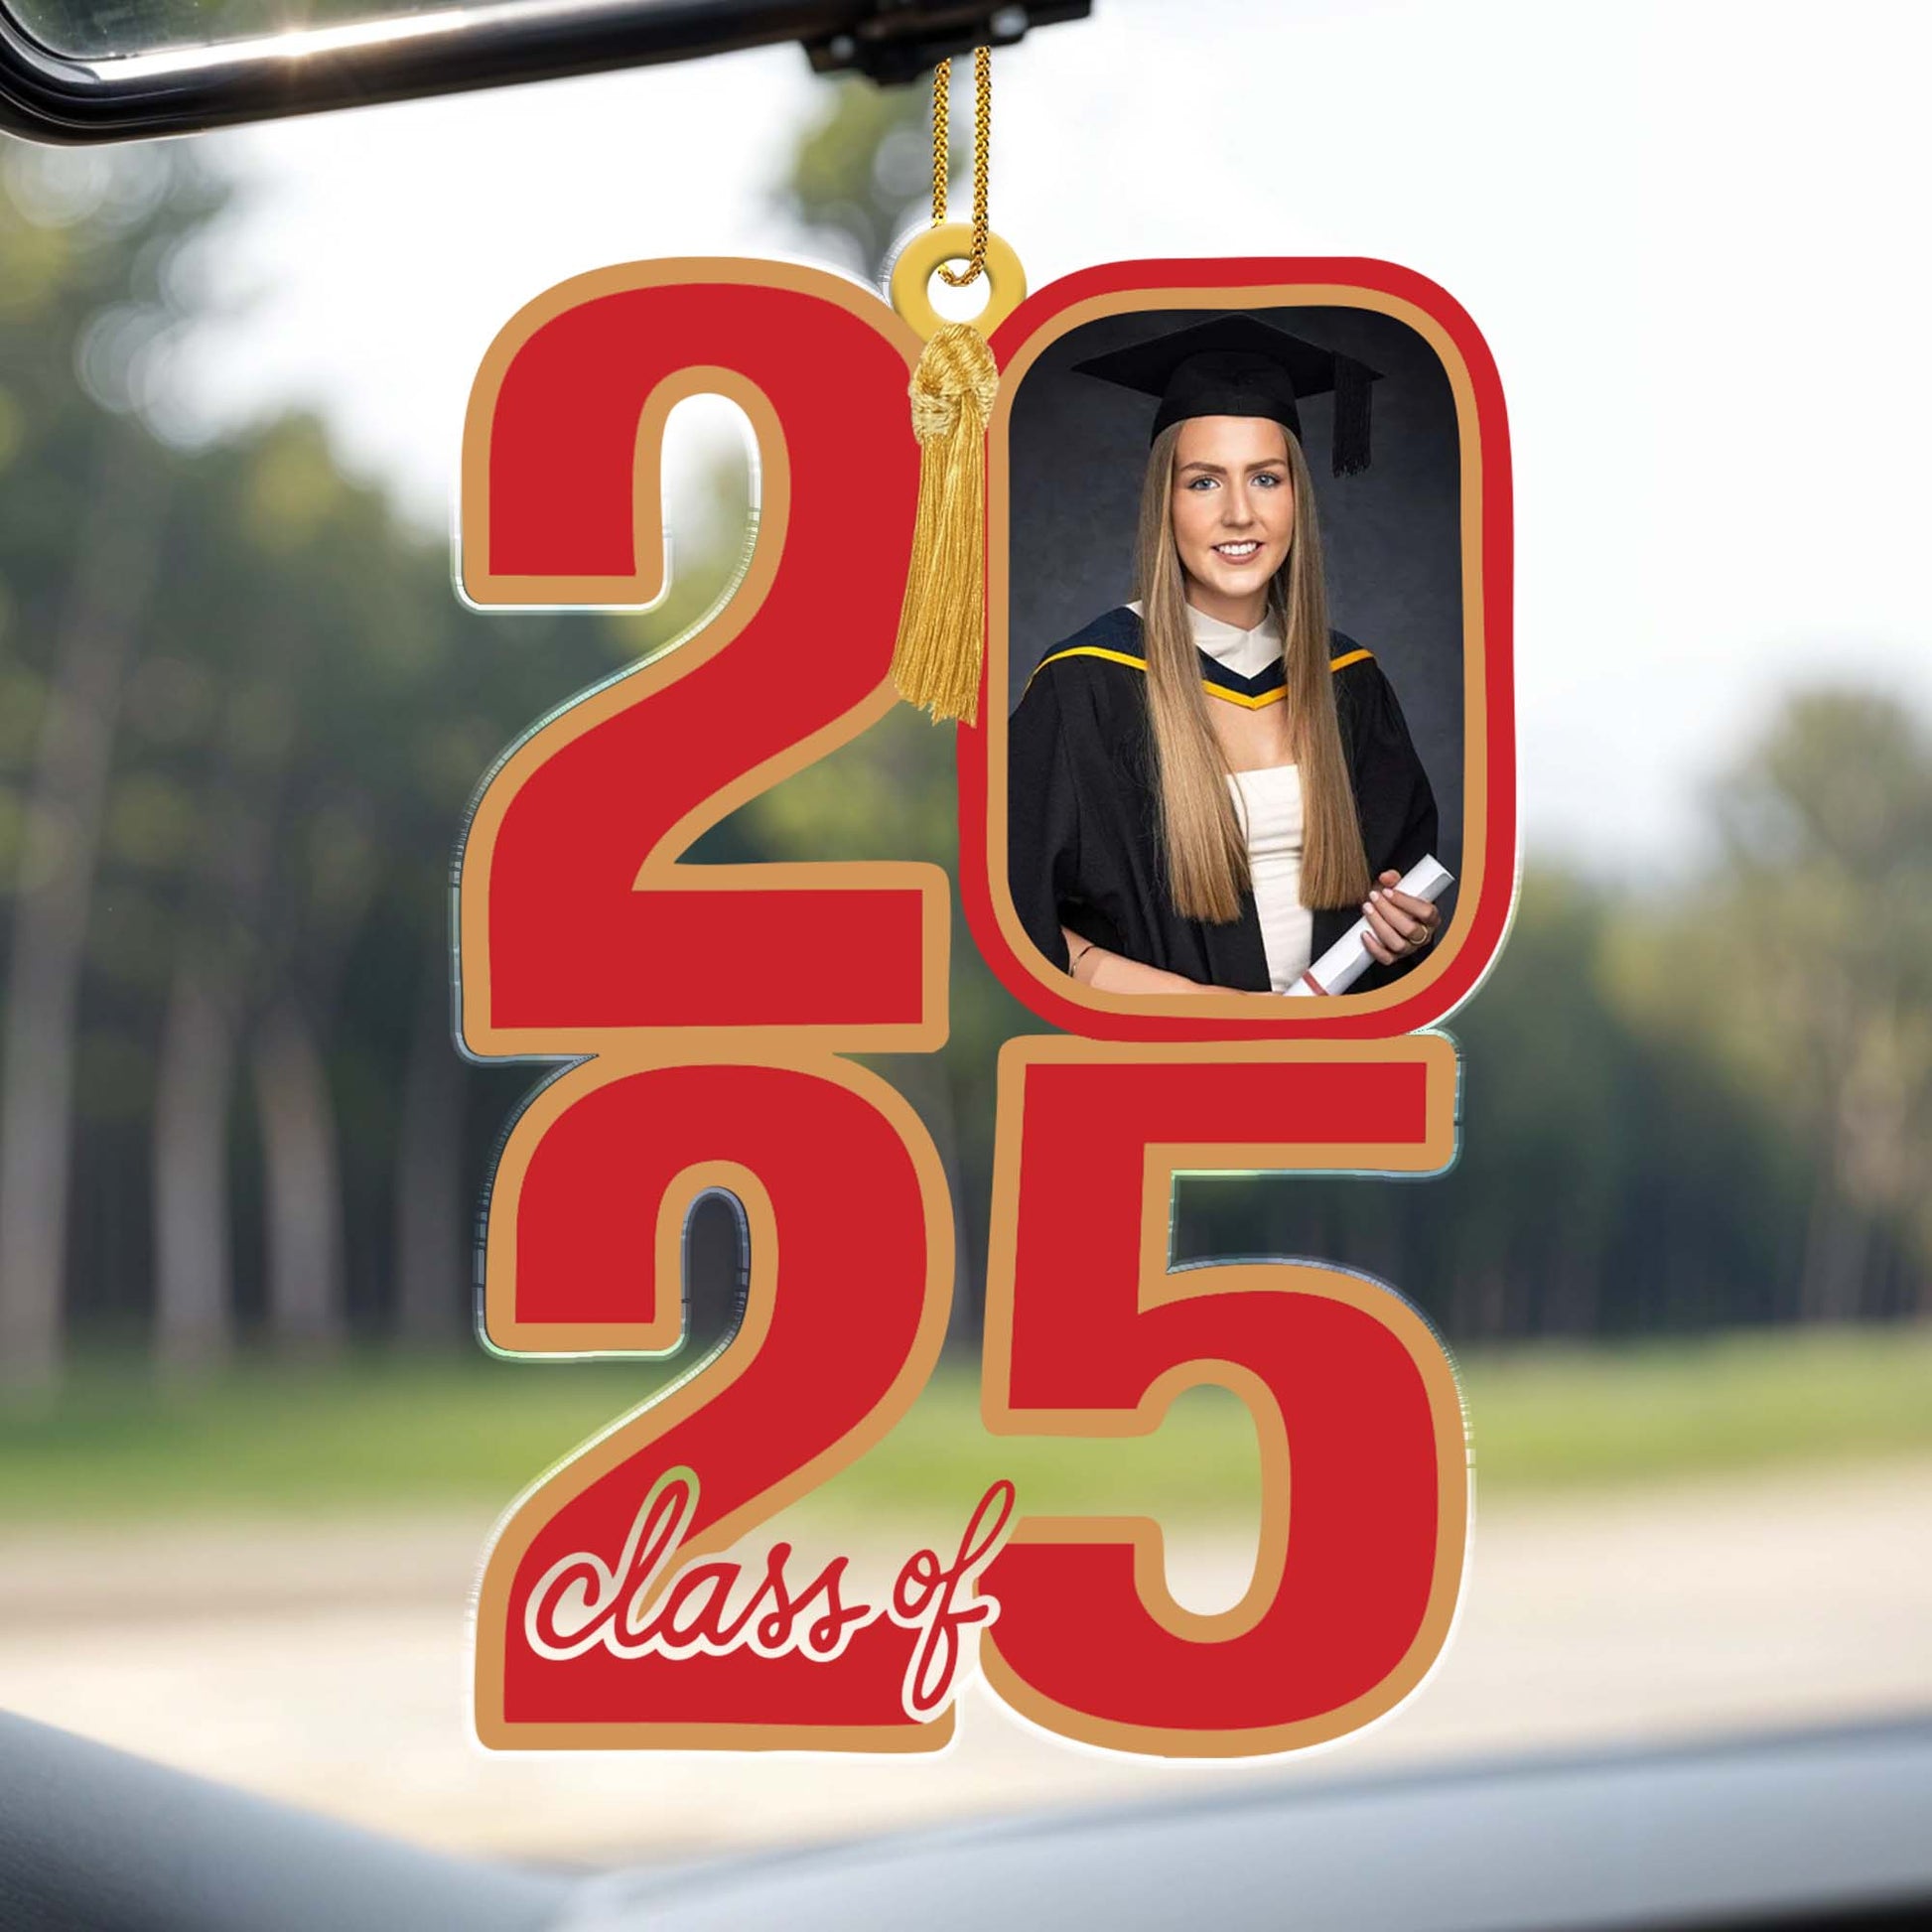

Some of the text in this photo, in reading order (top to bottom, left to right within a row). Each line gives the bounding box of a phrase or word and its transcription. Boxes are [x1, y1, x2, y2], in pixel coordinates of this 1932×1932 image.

[461, 256, 1516, 1055] 20
[475, 1035, 1472, 1756] 25
[534, 1478, 1016, 1714] class of
